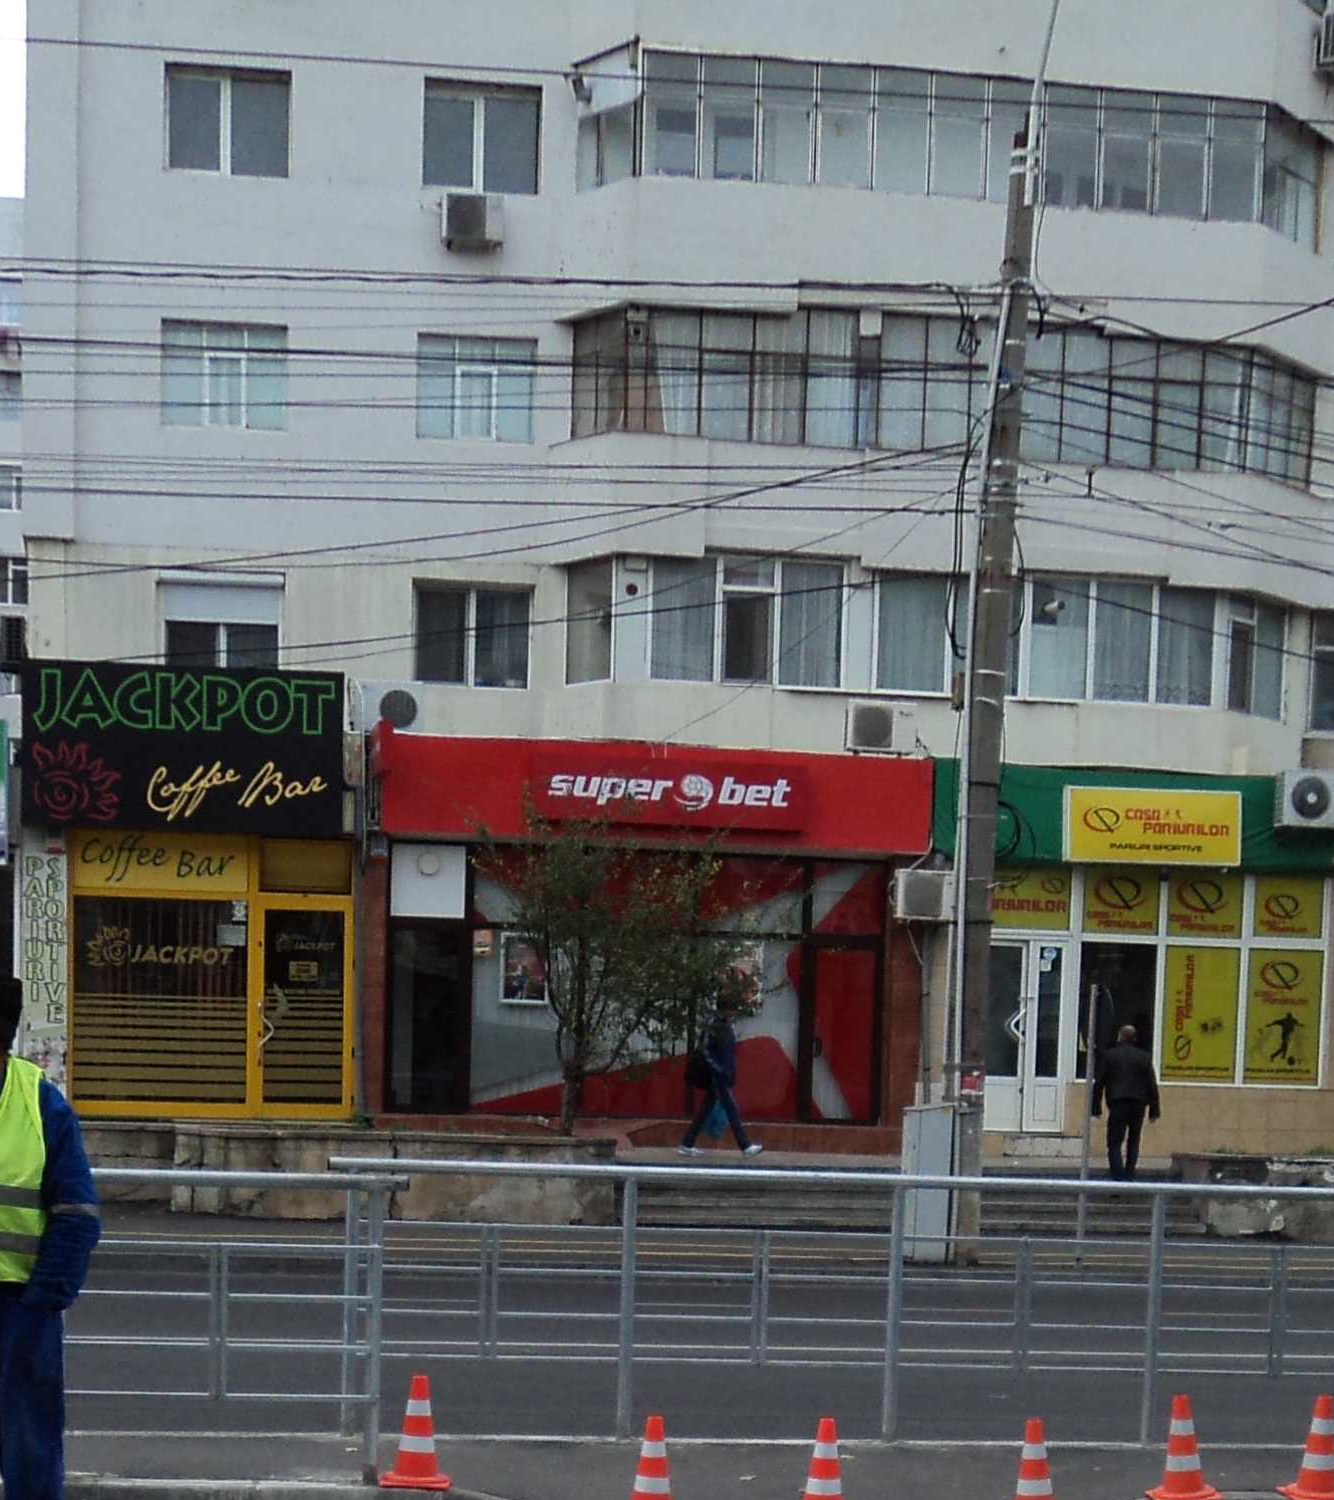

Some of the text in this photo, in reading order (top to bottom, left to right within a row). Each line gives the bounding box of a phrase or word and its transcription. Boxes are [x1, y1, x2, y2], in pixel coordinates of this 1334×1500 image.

[33, 668, 336, 734] JACKPOT
[147, 761, 327, 821] Coffee Bar
[548, 774, 791, 807] super bet
[1143, 822, 1229, 837] PARIURILOR
[80, 833, 235, 882] Coffee Bar
[25, 857, 45, 1002] PARIURI
[44, 857, 65, 1024] SPORTIVE
[294, 942, 336, 950] JACKPOT
[131, 944, 235, 965] JACKPOT
